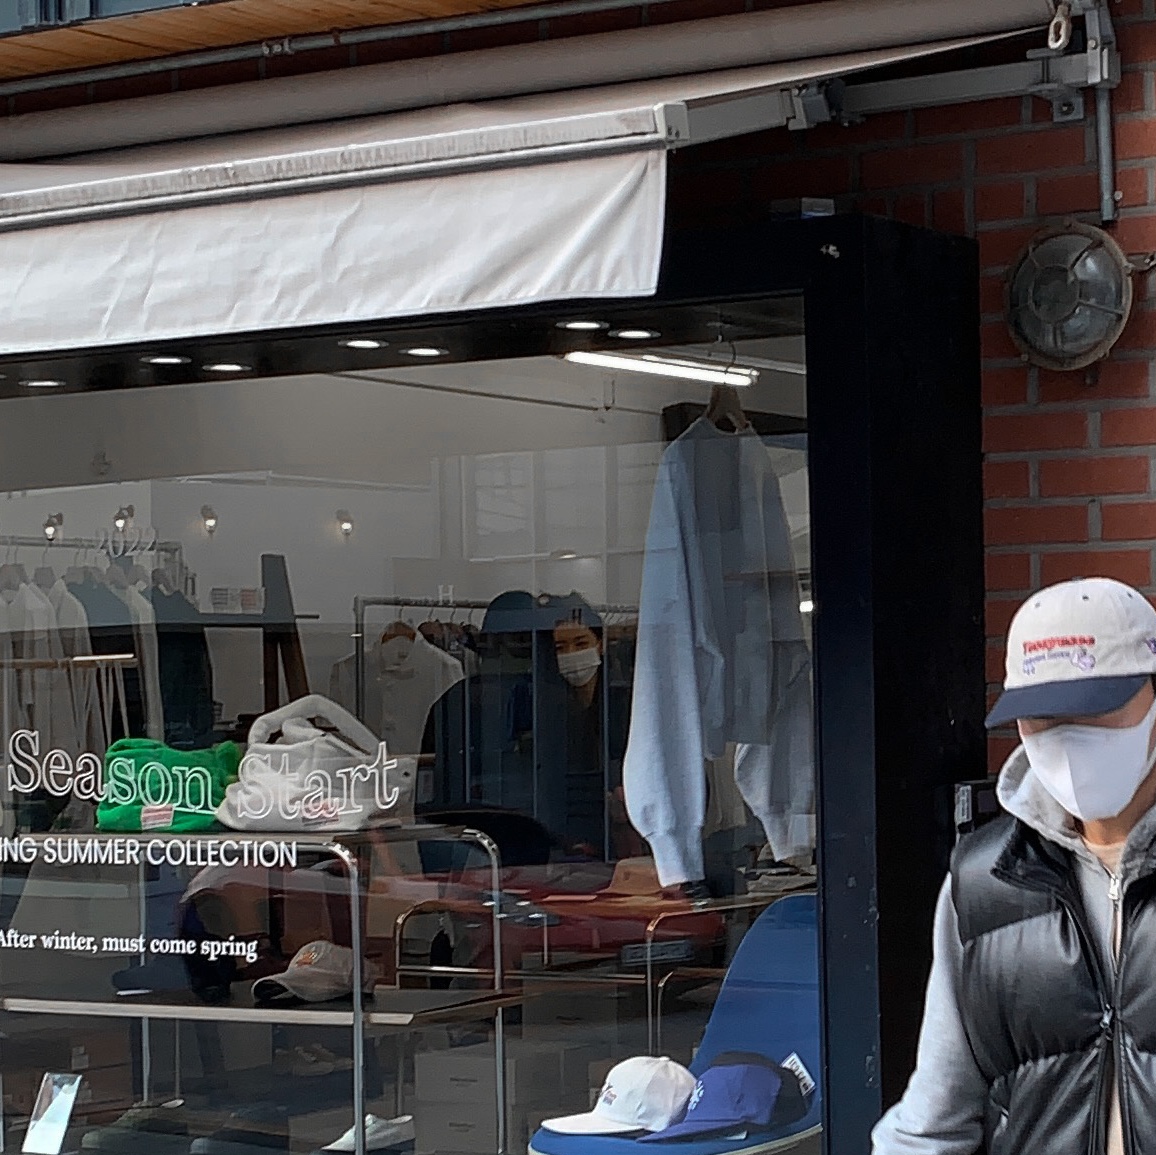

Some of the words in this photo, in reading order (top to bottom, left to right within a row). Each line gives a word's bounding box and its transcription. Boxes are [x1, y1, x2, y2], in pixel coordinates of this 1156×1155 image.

[96, 527, 159, 558] 2022
[8, 730, 217, 815] Season
[236, 741, 400, 819] Start
[43, 837, 140, 865] SUMMER
[146, 839, 298, 868] COLLECTION
[41, 930, 98, 953] winter,
[102, 935, 146, 953] must
[150, 938, 196, 955] come
[201, 936, 258, 963] spring
